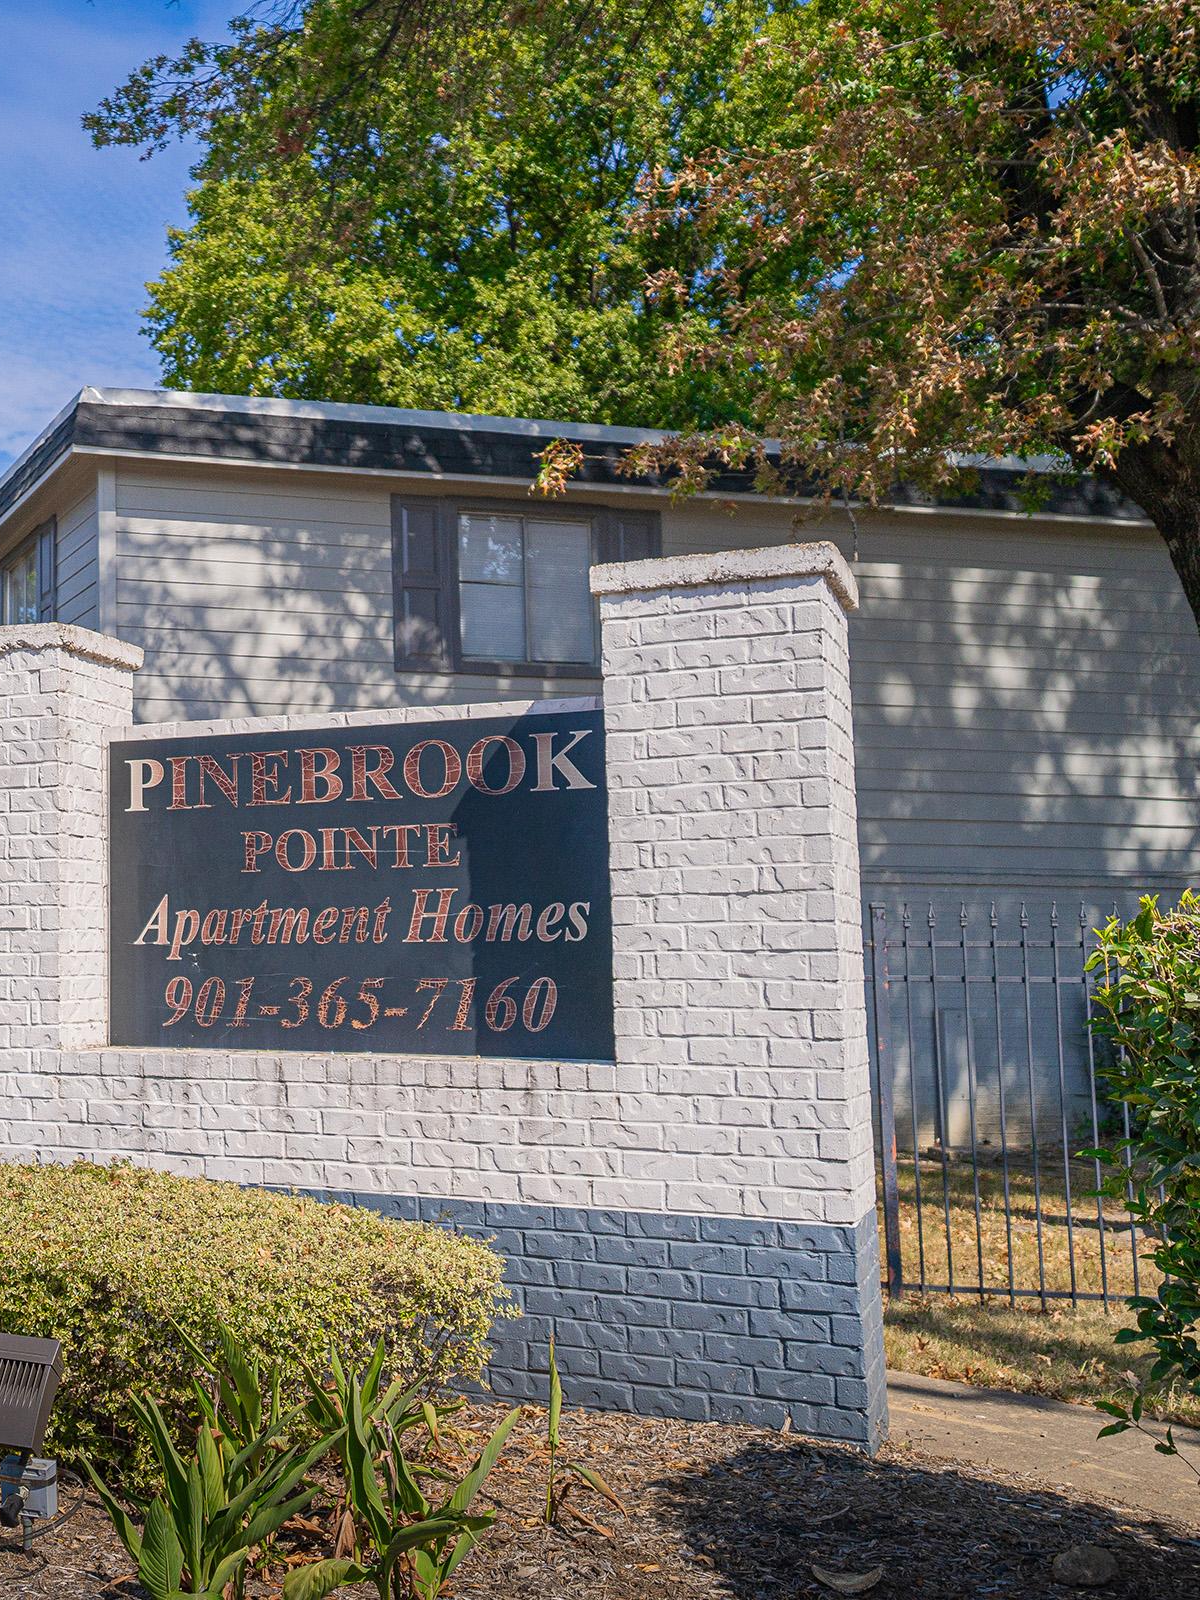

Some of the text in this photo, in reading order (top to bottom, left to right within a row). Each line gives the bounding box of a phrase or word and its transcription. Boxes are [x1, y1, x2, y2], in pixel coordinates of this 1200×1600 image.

[124, 730, 597, 812] PINEBROOK
[241, 822, 462, 873] POINTE
[134, 887, 591, 961] Apartment Homes
[162, 976, 559, 1033] 901-365-7160
